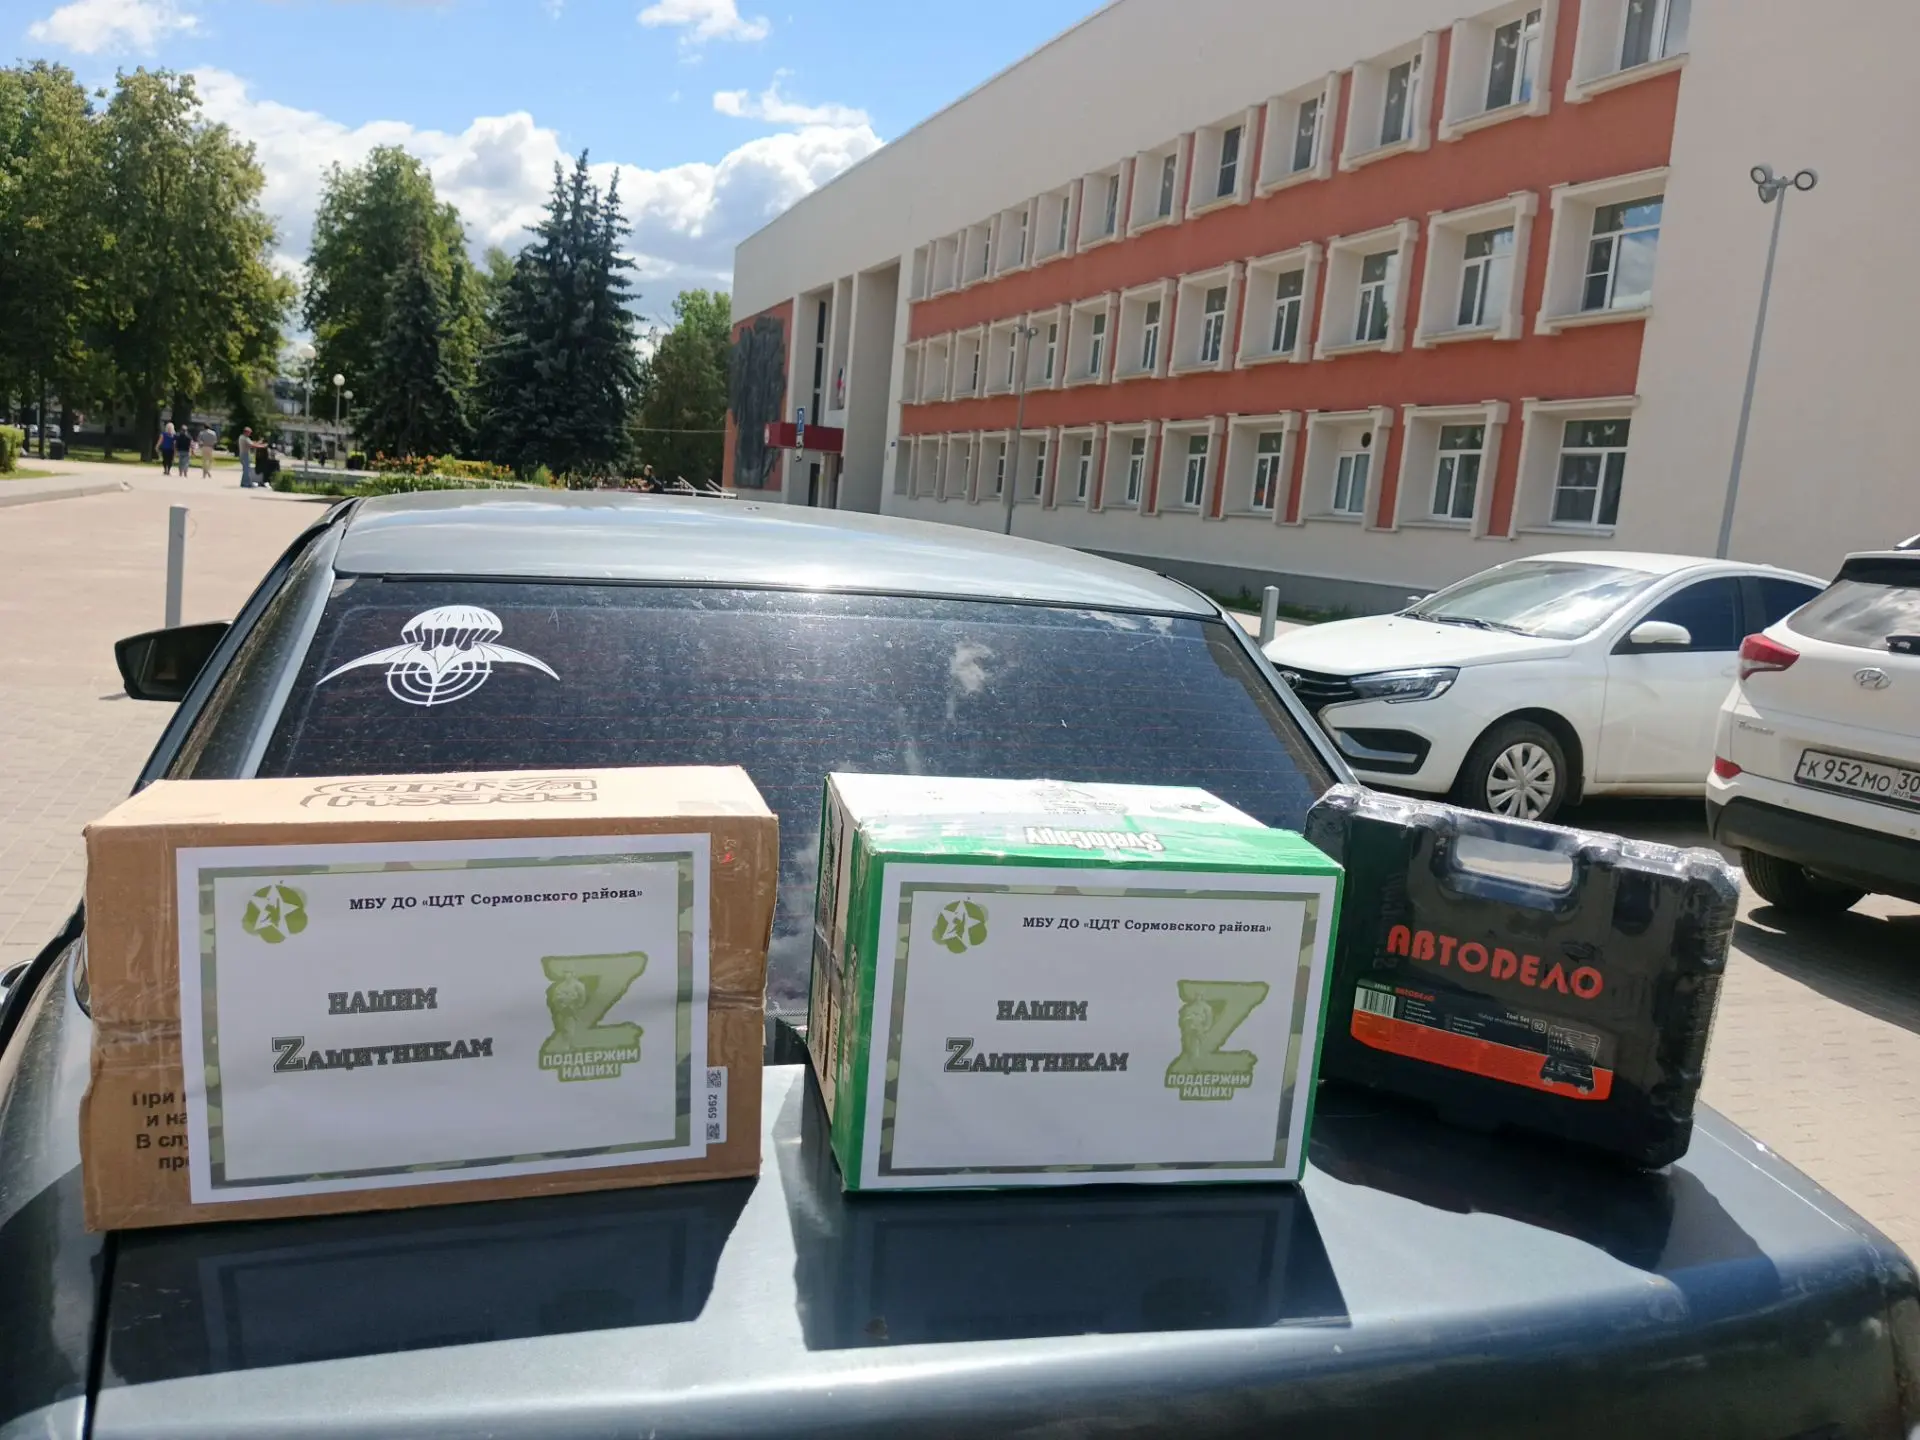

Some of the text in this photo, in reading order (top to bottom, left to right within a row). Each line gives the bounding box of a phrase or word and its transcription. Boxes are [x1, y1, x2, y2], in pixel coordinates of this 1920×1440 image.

[340, 779, 597, 793] LAND
[1893, 789, 1910, 798] RUS
[327, 791, 597, 807] FRESH
[1023, 826, 1165, 852] SvetoCopy
[350, 887, 643, 910] МБУ ДО «ЦДТ Сормовского района»
[1023, 917, 1271, 934] МБУ ДО «ЦДТ Сормовского района»
[328, 987, 438, 1015] НАШИМ
[996, 1000, 1088, 1021] НАШИМ
[543, 1049, 638, 1066] ПОДДЕРЖИМ
[563, 1063, 618, 1078] НАШИХ!
[1168, 1074, 1250, 1085] ПОДДЕРЖИМ
[132, 1090, 174, 1108] При
[1183, 1086, 1232, 1097] НАШИХ!
[707, 1094, 718, 1119] 5962
[146, 1114, 159, 1127] и
[136, 1134, 151, 1149] В
